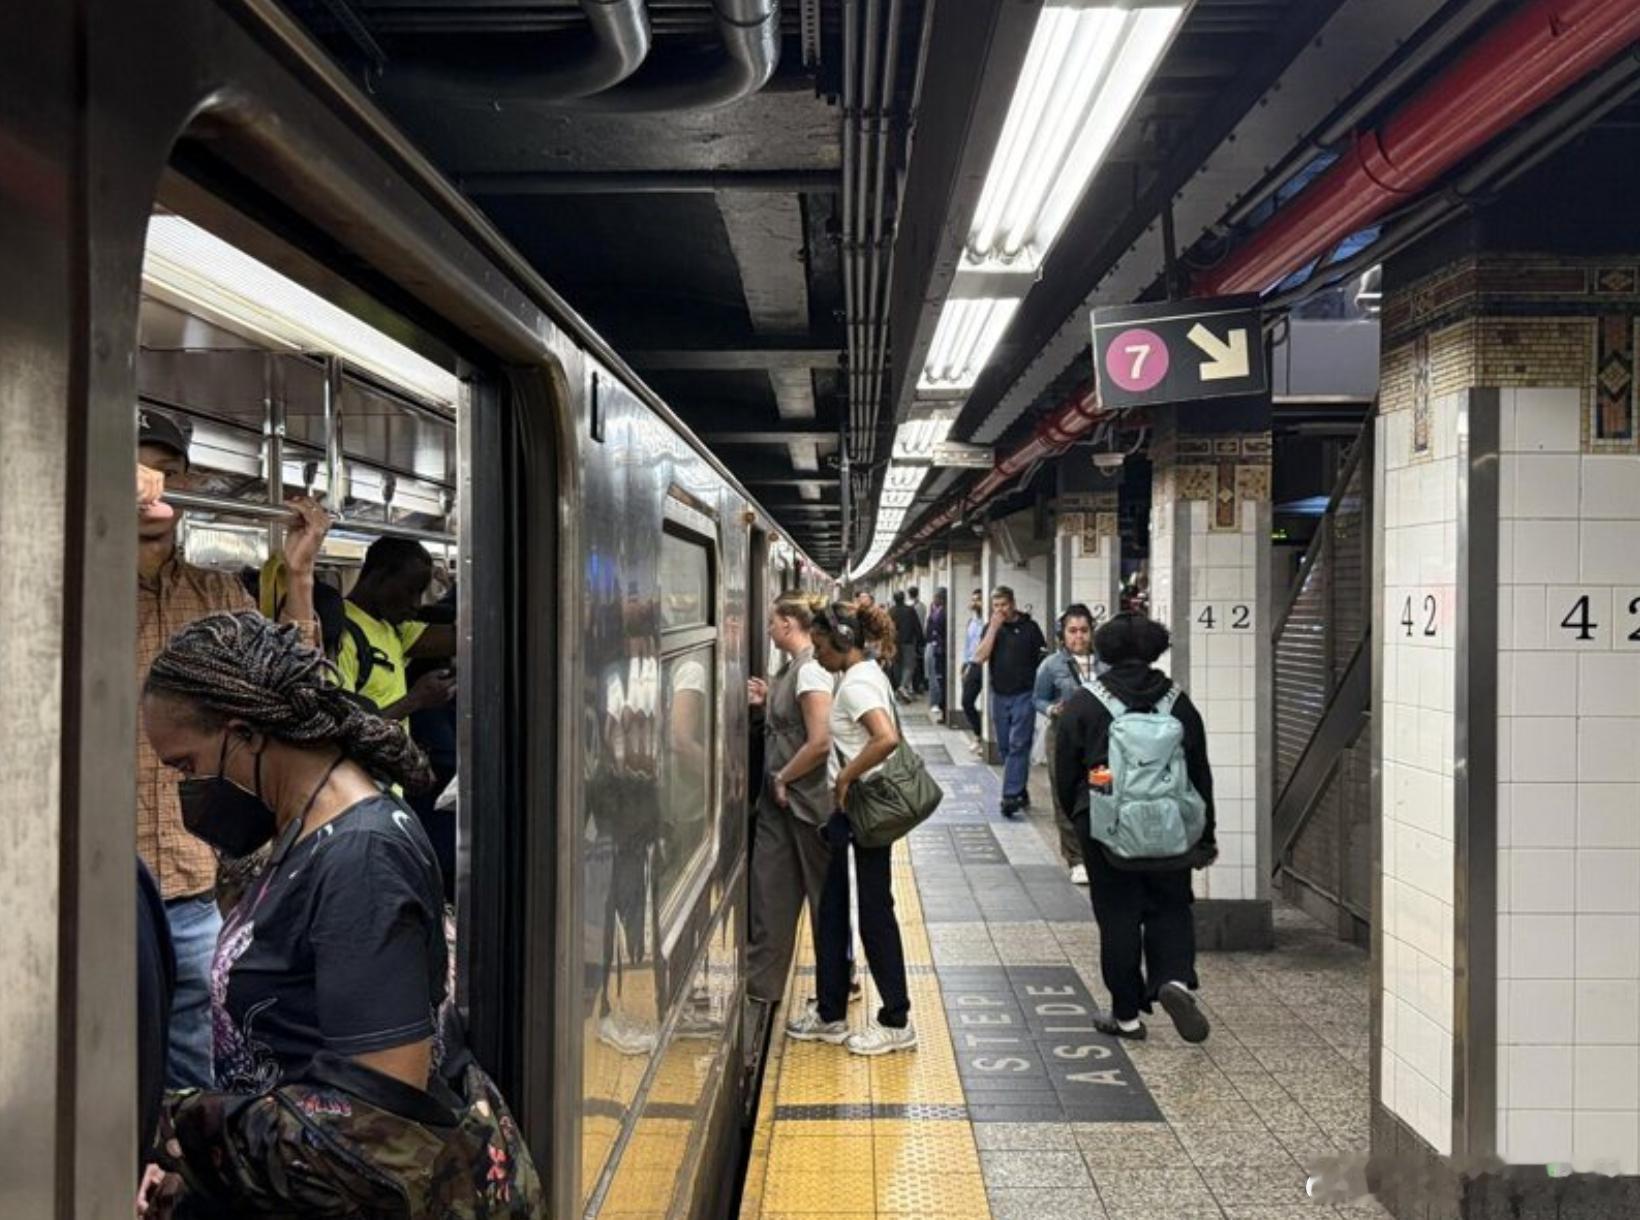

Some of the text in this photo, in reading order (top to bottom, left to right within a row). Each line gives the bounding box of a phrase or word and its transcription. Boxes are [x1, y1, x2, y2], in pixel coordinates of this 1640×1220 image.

[1125, 344, 1151, 379] 7
[1197, 604, 1250, 629] 42
[1401, 594, 1437, 637] 42
[957, 995, 1030, 1072] STEP
[1025, 985, 1128, 1086] ASIDE
